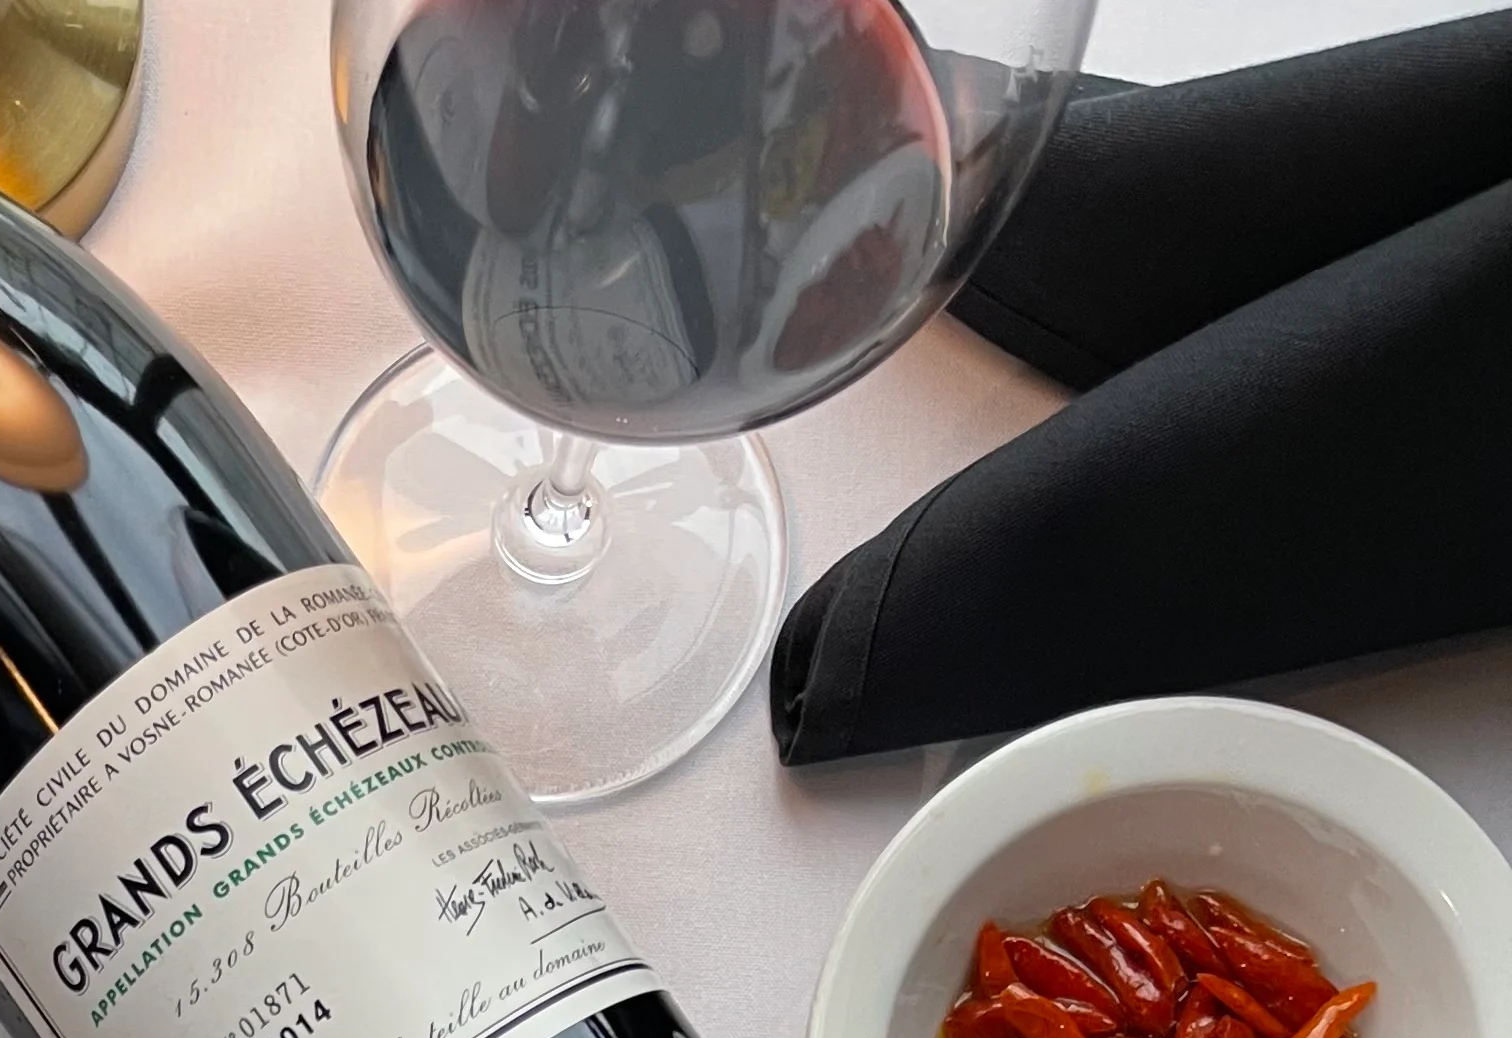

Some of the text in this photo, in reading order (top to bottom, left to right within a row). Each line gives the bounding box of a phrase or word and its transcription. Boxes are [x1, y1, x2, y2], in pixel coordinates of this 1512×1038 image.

[36, 748, 91, 807] CIVILE
[96, 715, 127, 748] DU
[134, 640, 229, 715] DOMAINE
[236, 619, 265, 644] DE
[270, 605, 296, 626] LA
[6, 776, 103, 886] PROPRIÉTAIRE
[52, 801, 234, 997] GRANDS
[90, 903, 203, 1028] APPELLATION
[212, 823, 304, 899] GRANDS
[308, 753, 428, 826] ÉCHÉZEAUX
[174, 778, 502, 1018] 15.308 Bouteilles Récoltées
[431, 847, 457, 868] LES
[498, 976, 528, 1001] au
[533, 939, 606, 981] domaine
